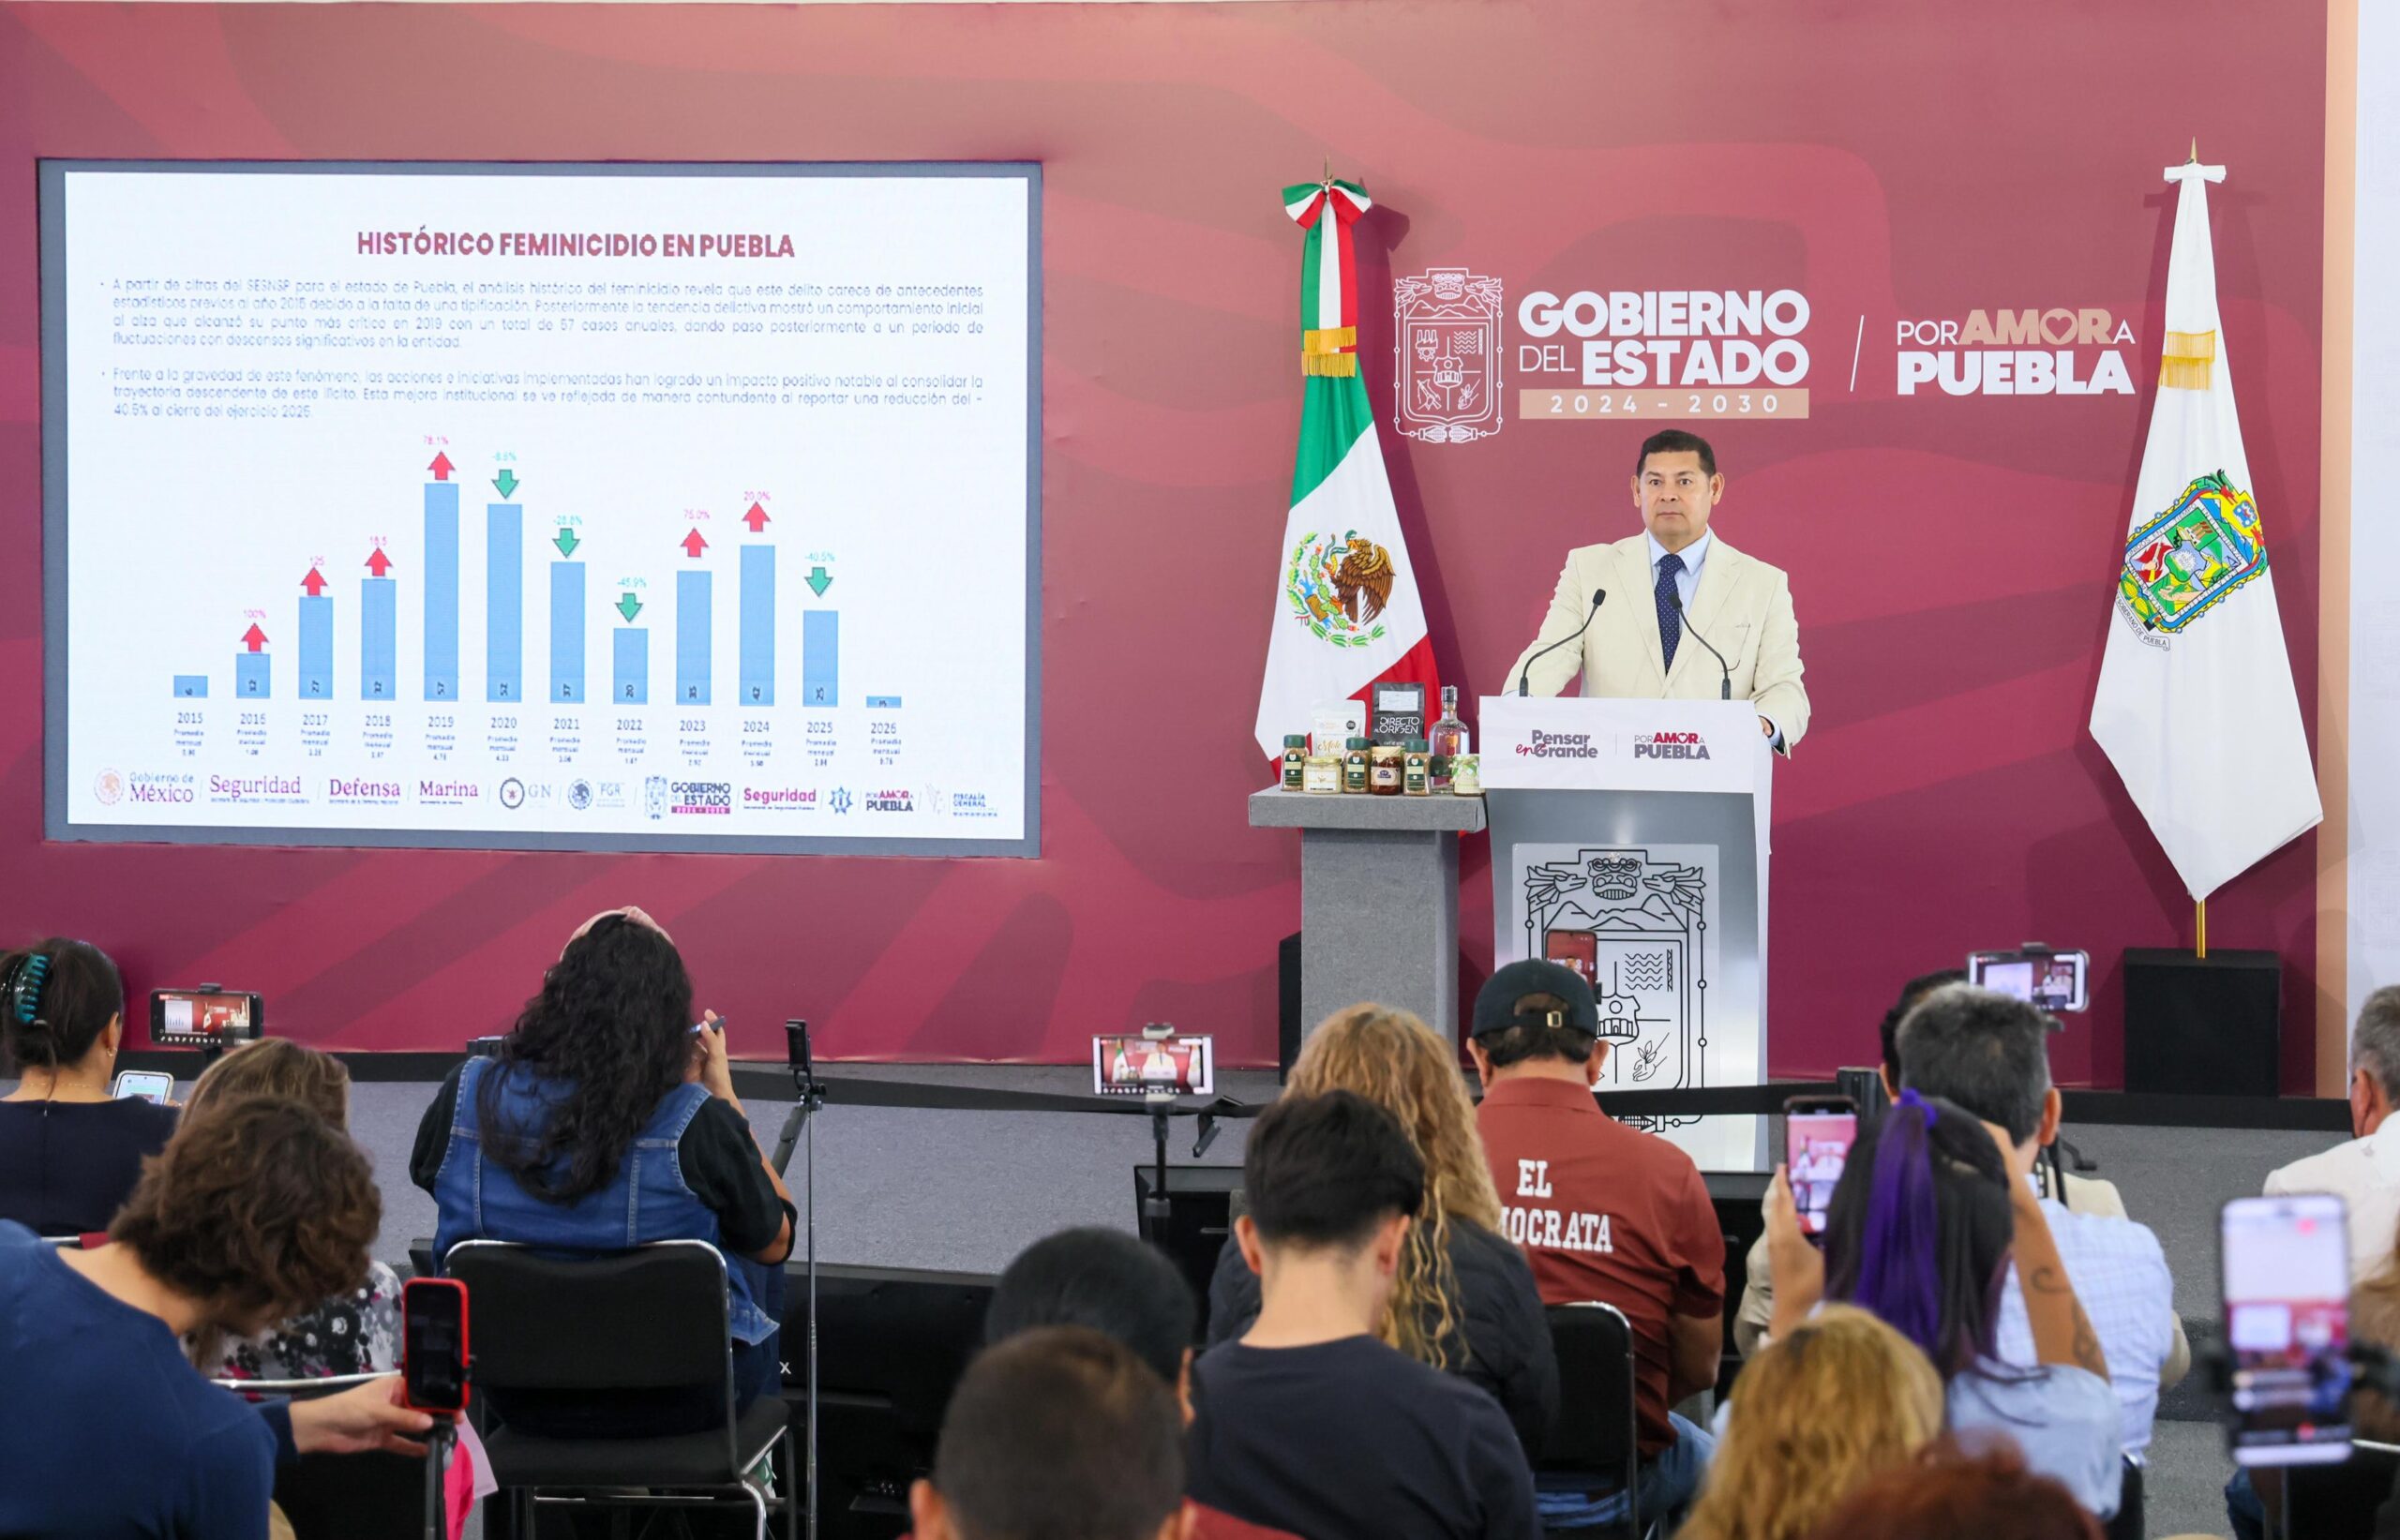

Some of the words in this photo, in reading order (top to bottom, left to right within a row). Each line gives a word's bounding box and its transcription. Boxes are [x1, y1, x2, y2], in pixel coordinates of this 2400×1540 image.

[358, 225, 493, 256] HISTÓRICO
[500, 232, 656, 257] FEMINICIDIO
[662, 233, 696, 258] EN
[700, 234, 795, 258] PUEBLA
[125, 279, 160, 293] partir
[222, 279, 243, 291] del
[294, 282, 325, 294] para
[344, 280, 389, 292] estado
[529, 282, 583, 293] histórico
[587, 282, 608, 293] del
[610, 282, 681, 293] feminicidio
[684, 283, 724, 294] revela
[727, 285, 752, 297] que
[756, 283, 784, 294] este
[788, 284, 824, 295] delito
[826, 286, 872, 295] carece
[895, 285, 984, 296] antecedentes
[112, 298, 188, 308] estadísticos
[189, 298, 234, 312] previos
[252, 298, 278, 309] año
[309, 299, 354, 309] debido
[382, 299, 412, 310] falta
[433, 302, 458, 310] una
[534, 300, 630, 311] Posteriormente
[647, 301, 711, 312] tendencia
[712, 301, 767, 312] delictiva
[769, 302, 815, 312] mostró
[836, 302, 944, 316] comportamiento
[946, 303, 983, 313] inicial
[1518, 290, 1810, 338] GOBIERNO
[130, 317, 158, 327] alza
[162, 319, 188, 331] que
[194, 317, 244, 328] alcanzó
[270, 318, 308, 332] punto
[314, 318, 342, 329] más
[347, 318, 387, 329] crítico
[415, 319, 443, 329] 2019
[448, 321, 473, 329] con
[502, 319, 532, 330] total
[580, 321, 619, 330] casos
[683, 320, 726, 331] dando
[731, 322, 765, 335] paso
[770, 321, 867, 335] posteriormente
[911, 321, 961, 336] periodo
[1898, 321, 1958, 346] POR
[1958, 307, 2113, 345] AMOR
[2112, 320, 2136, 344] A
[112, 335, 197, 346] fluctuaciones
[199, 337, 223, 346] con
[225, 336, 292, 347] descensos
[294, 336, 376, 350] significativos
[1520, 345, 1575, 372] DEL
[1582, 338, 1810, 386] ESTADO
[112, 369, 153, 381] Frente
[182, 370, 244, 384] gravedad
[265, 370, 293, 381] este
[386, 371, 443, 383] acciones
[457, 372, 520, 383] iniciativas
[523, 373, 622, 387] implementadas
[653, 374, 703, 388] logrado
[726, 374, 780, 389] impacto
[782, 375, 832, 389] positivo
[834, 375, 883, 386] notable
[900, 376, 968, 387] consolidar
[1898, 351, 2136, 396] PUEBLA
[112, 388, 182, 402] trayectoria
[185, 389, 268, 399] descendente
[292, 389, 320, 399] este
[363, 390, 390, 400] Esta
[393, 392, 439, 404] mejora
[442, 391, 518, 401] institucional
[560, 391, 617, 405] reflejada
[641, 394, 692, 402] manera
[696, 392, 777, 403] contundente
[798, 393, 850, 407] reportar
[883, 394, 947, 404] reducción
[1550, 396, 1639, 413] 2024
[1688, 396, 1779, 413] 2030
[165, 406, 202, 417] cierre
[225, 407, 279, 421] ejercicio
[2117, 599, 2138, 628] SOBERANO
[2143, 635, 2167, 646] PUEBLA
[177, 712, 203, 724] 2015
[303, 714, 329, 725] 2017
[366, 715, 391, 726] 2018
[491, 717, 517, 728] 2020
[554, 718, 579, 729] 2021
[617, 720, 643, 731] 2022
[680, 721, 706, 732] 2023
[743, 721, 770, 732] 2024
[807, 722, 833, 733] 2025
[871, 723, 896, 734] 2026
[1379, 725, 1418, 734] ORIGEN
[1380, 717, 1419, 725] DIRECTO
[1532, 729, 1590, 745] Pensar
[1634, 735, 1653, 743] POR
[1653, 732, 1699, 744] AMOR
[1535, 743, 1598, 758] Grande
[1634, 744, 1710, 760] PUEBLA
[129, 772, 175, 783] Gobierno
[178, 773, 194, 784] de
[210, 775, 301, 798] Seguridad
[329, 777, 400, 797] Defensa
[129, 783, 194, 802] México
[419, 779, 479, 798] Marina
[670, 782, 731, 794] GOBIERNO
[743, 787, 817, 804] Seguridad
[684, 795, 731, 807] ESTADO
[866, 800, 914, 812] PUEBLA
[1516, 1159, 1552, 1198] EL
